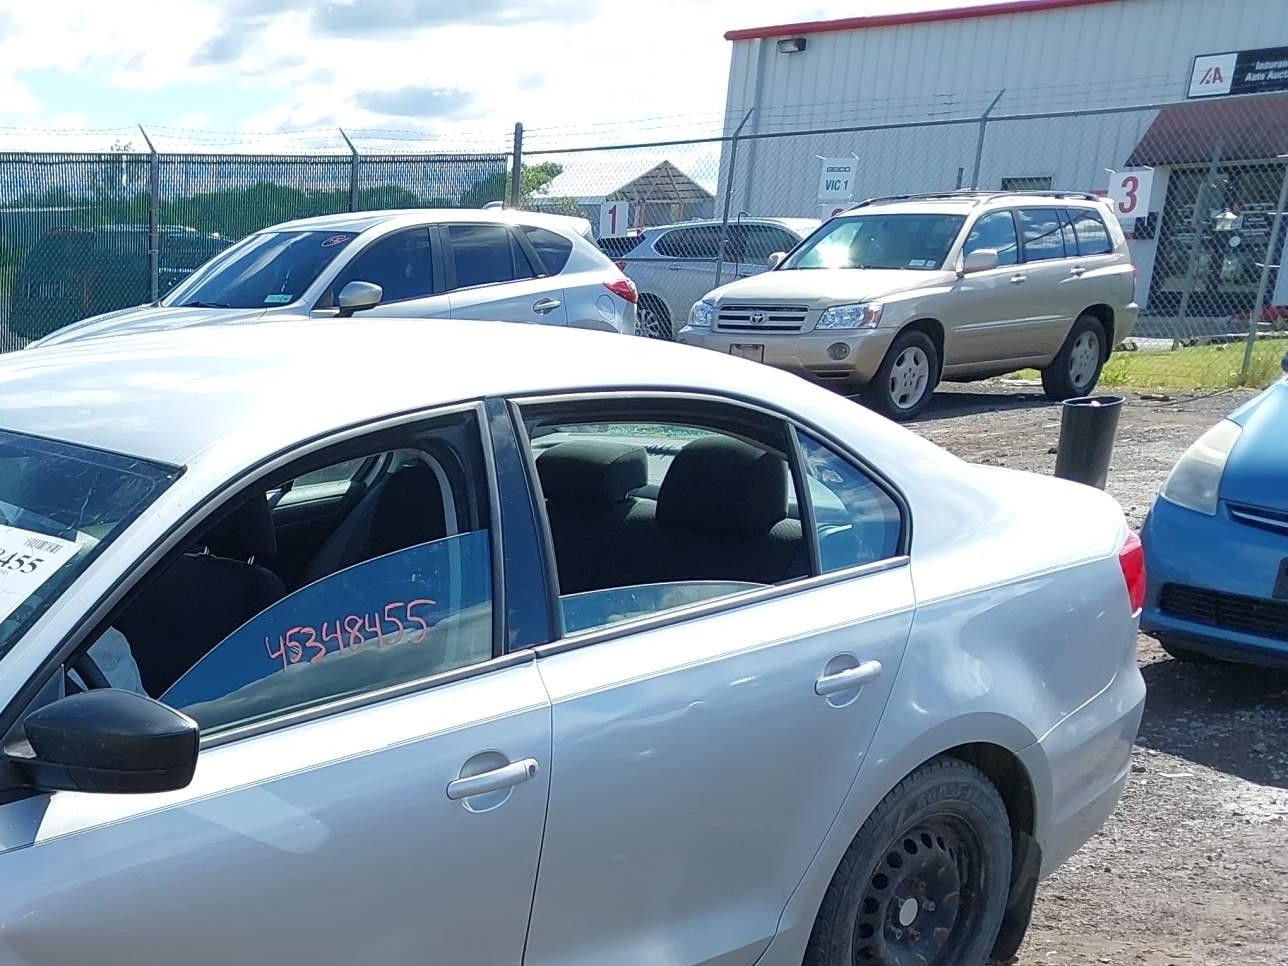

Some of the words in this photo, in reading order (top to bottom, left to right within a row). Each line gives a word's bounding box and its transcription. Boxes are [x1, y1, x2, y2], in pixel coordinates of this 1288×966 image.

[1244, 72, 1266, 82] Auto
[825, 179, 841, 191] VIC
[843, 179, 849, 191] 1
[1118, 176, 1139, 214] 3
[608, 204, 617, 235] 1
[265, 599, 436, 673] 45348455
